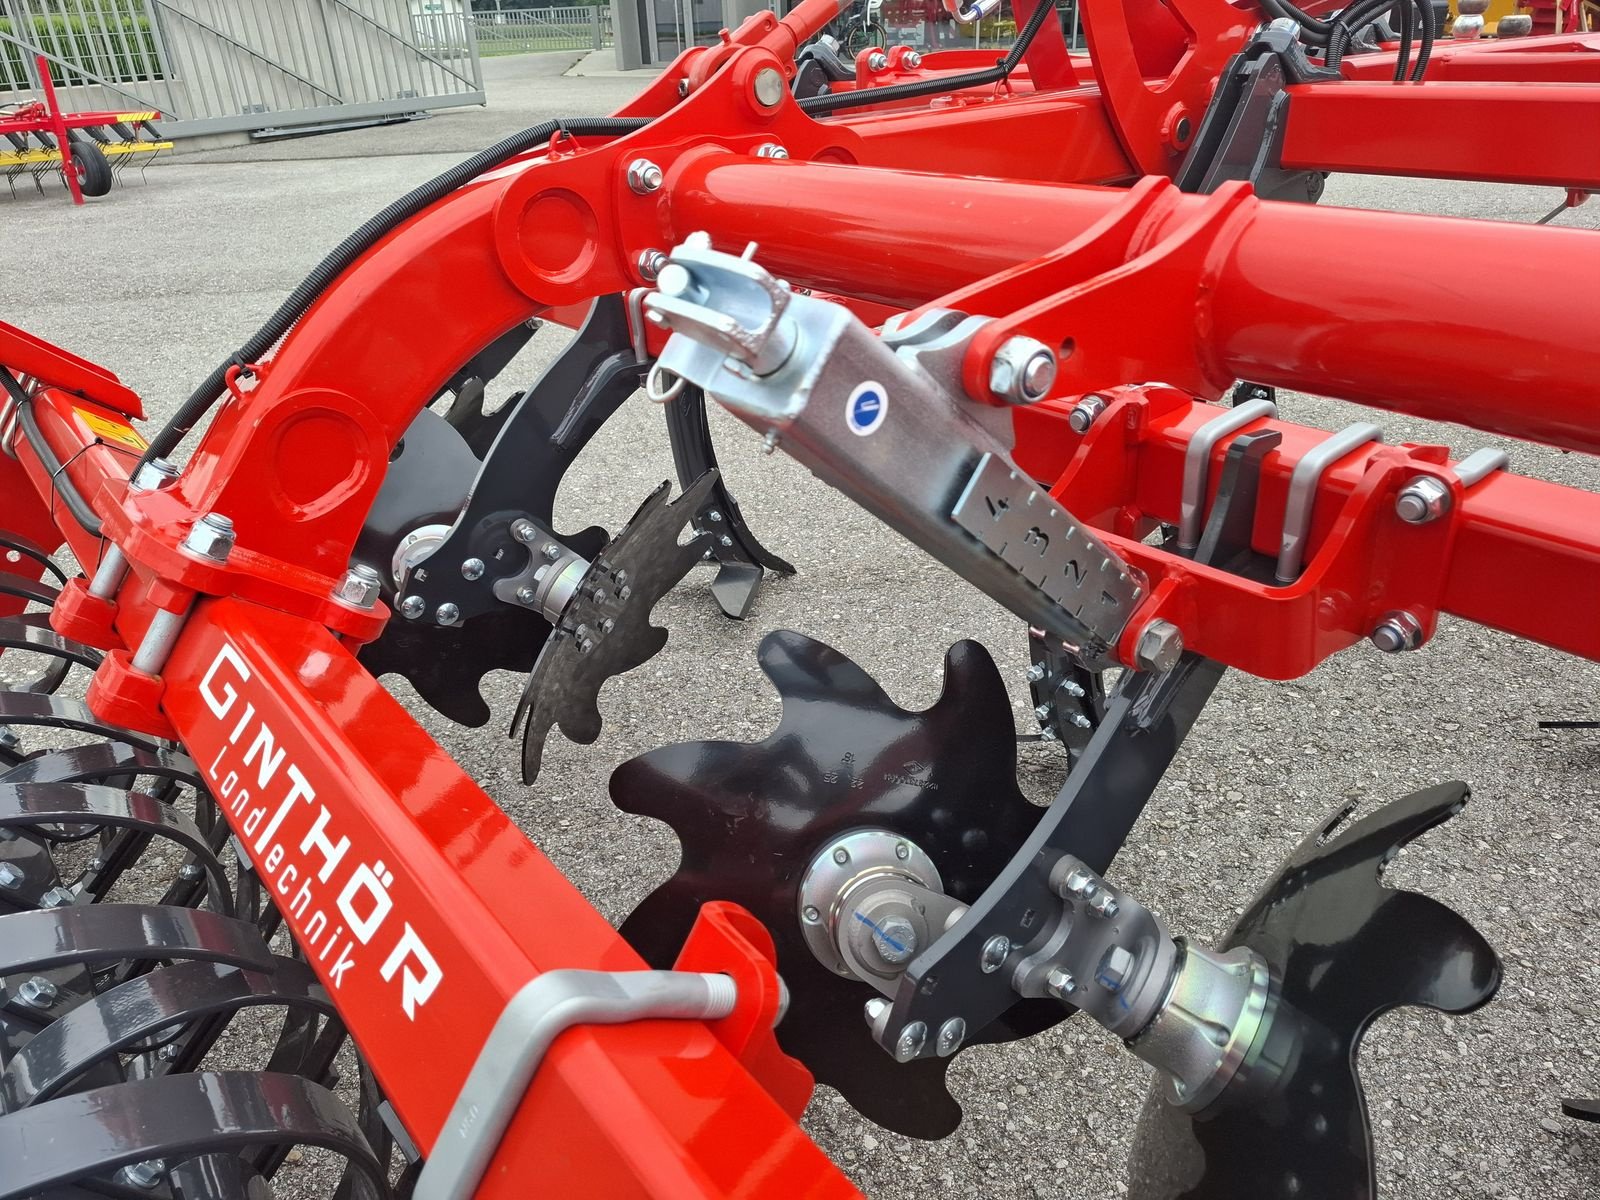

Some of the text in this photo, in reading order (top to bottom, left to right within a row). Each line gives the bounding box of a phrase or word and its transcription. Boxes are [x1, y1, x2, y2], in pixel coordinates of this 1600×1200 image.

[984, 495, 1010, 522] 4
[1024, 526, 1050, 558] 3
[1064, 559, 1088, 588] 2
[1101, 590, 1119, 608] 1
[198, 642, 444, 1022] GINTHÖR
